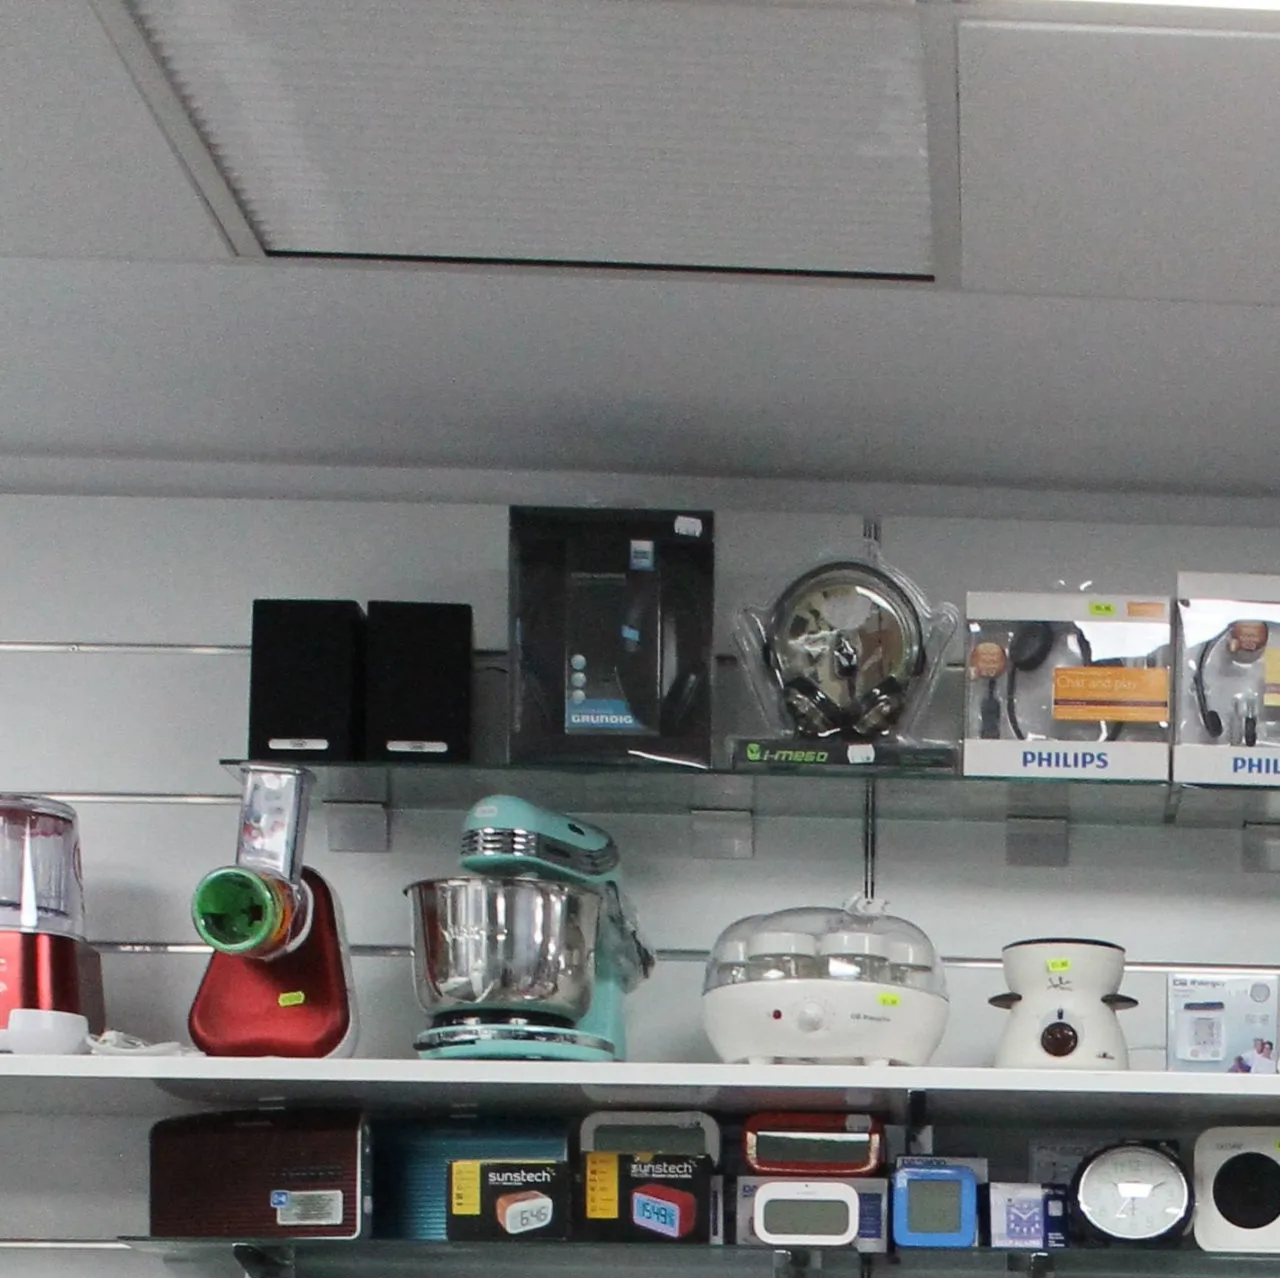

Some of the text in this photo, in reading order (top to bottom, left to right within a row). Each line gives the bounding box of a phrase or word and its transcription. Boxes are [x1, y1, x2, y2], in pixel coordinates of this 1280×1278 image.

[571, 714, 634, 724] GRUNDIG
[1022, 751, 1109, 769] PHILIPS
[488, 1169, 551, 1182] sunstech
